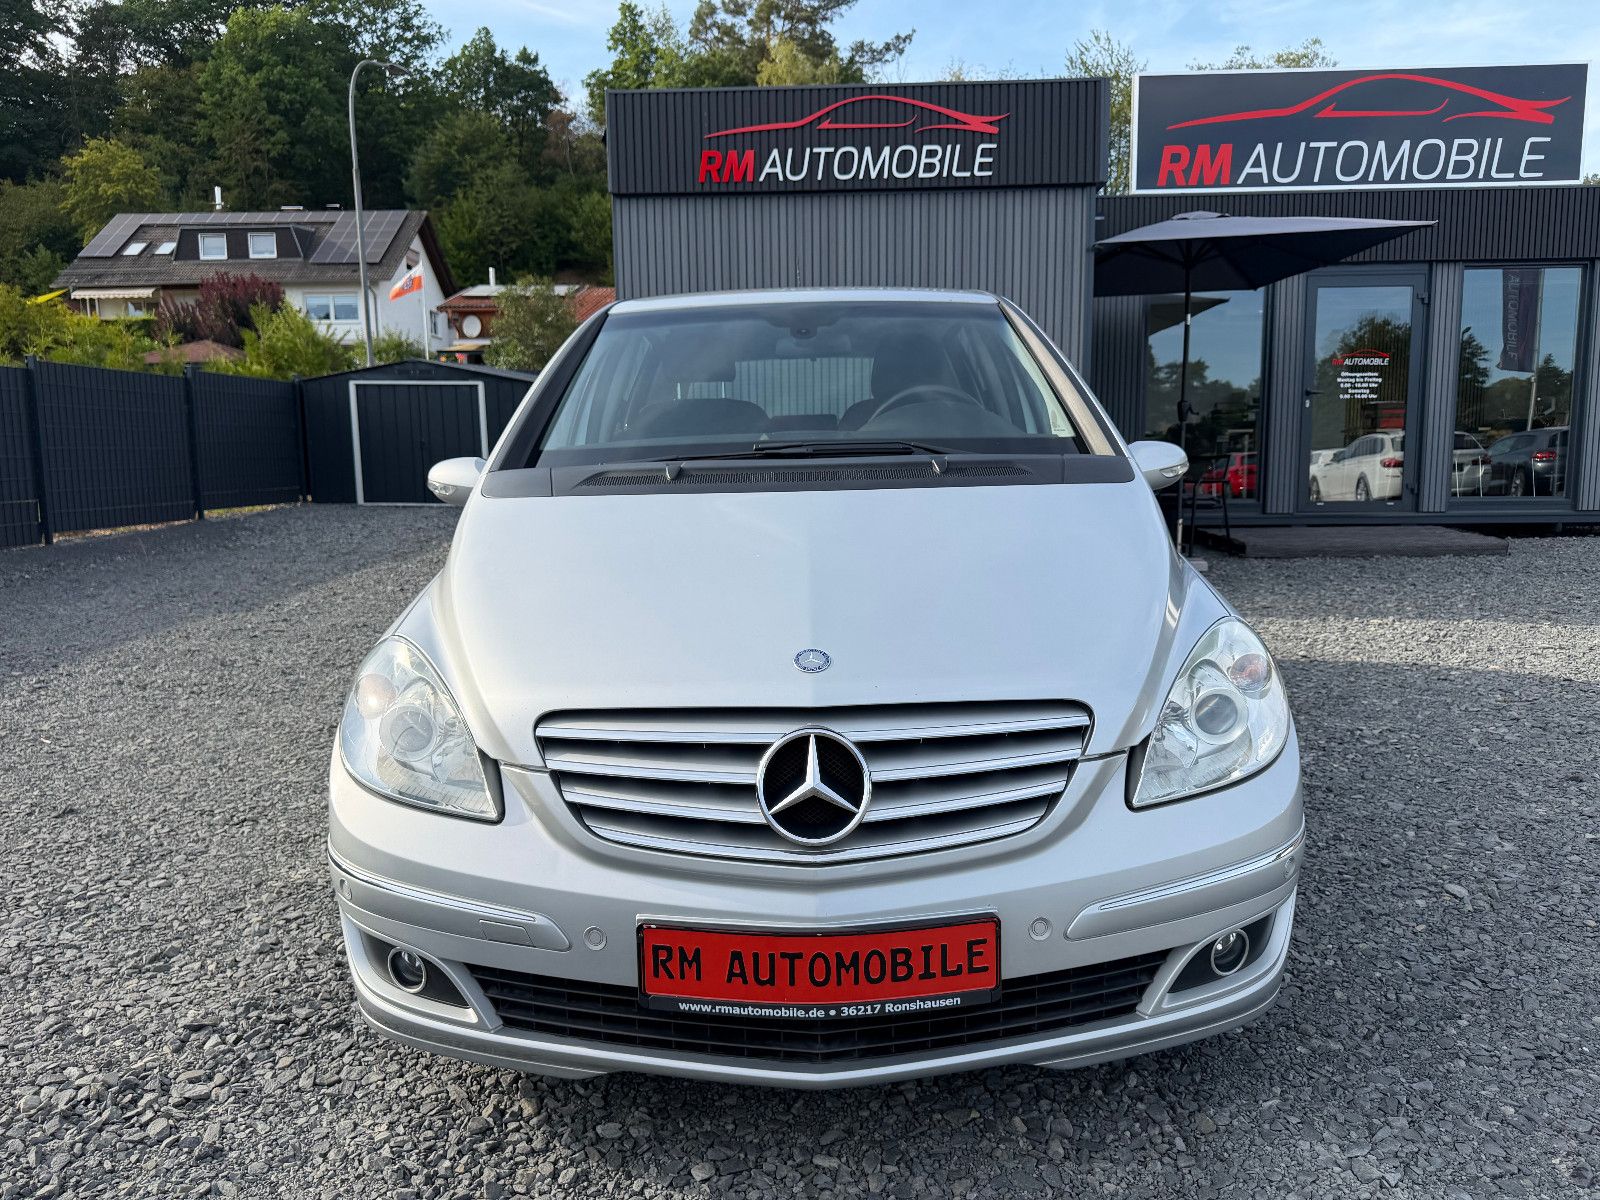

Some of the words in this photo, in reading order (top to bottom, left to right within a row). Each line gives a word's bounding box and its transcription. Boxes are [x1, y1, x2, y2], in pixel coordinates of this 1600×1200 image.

[698, 149, 755, 183] RM
[758, 142, 998, 182] AUTOMOBILE
[1157, 143, 1234, 187] RM
[1236, 136, 1552, 184] AUTOMOBILE
[651, 944, 703, 982] RM
[725, 937, 990, 988] AUTOMOBILE
[678, 1000, 825, 1018] www.rmautomobile.de
[840, 1003, 882, 1018] 36217
[884, 996, 962, 1014] Ronshausen
